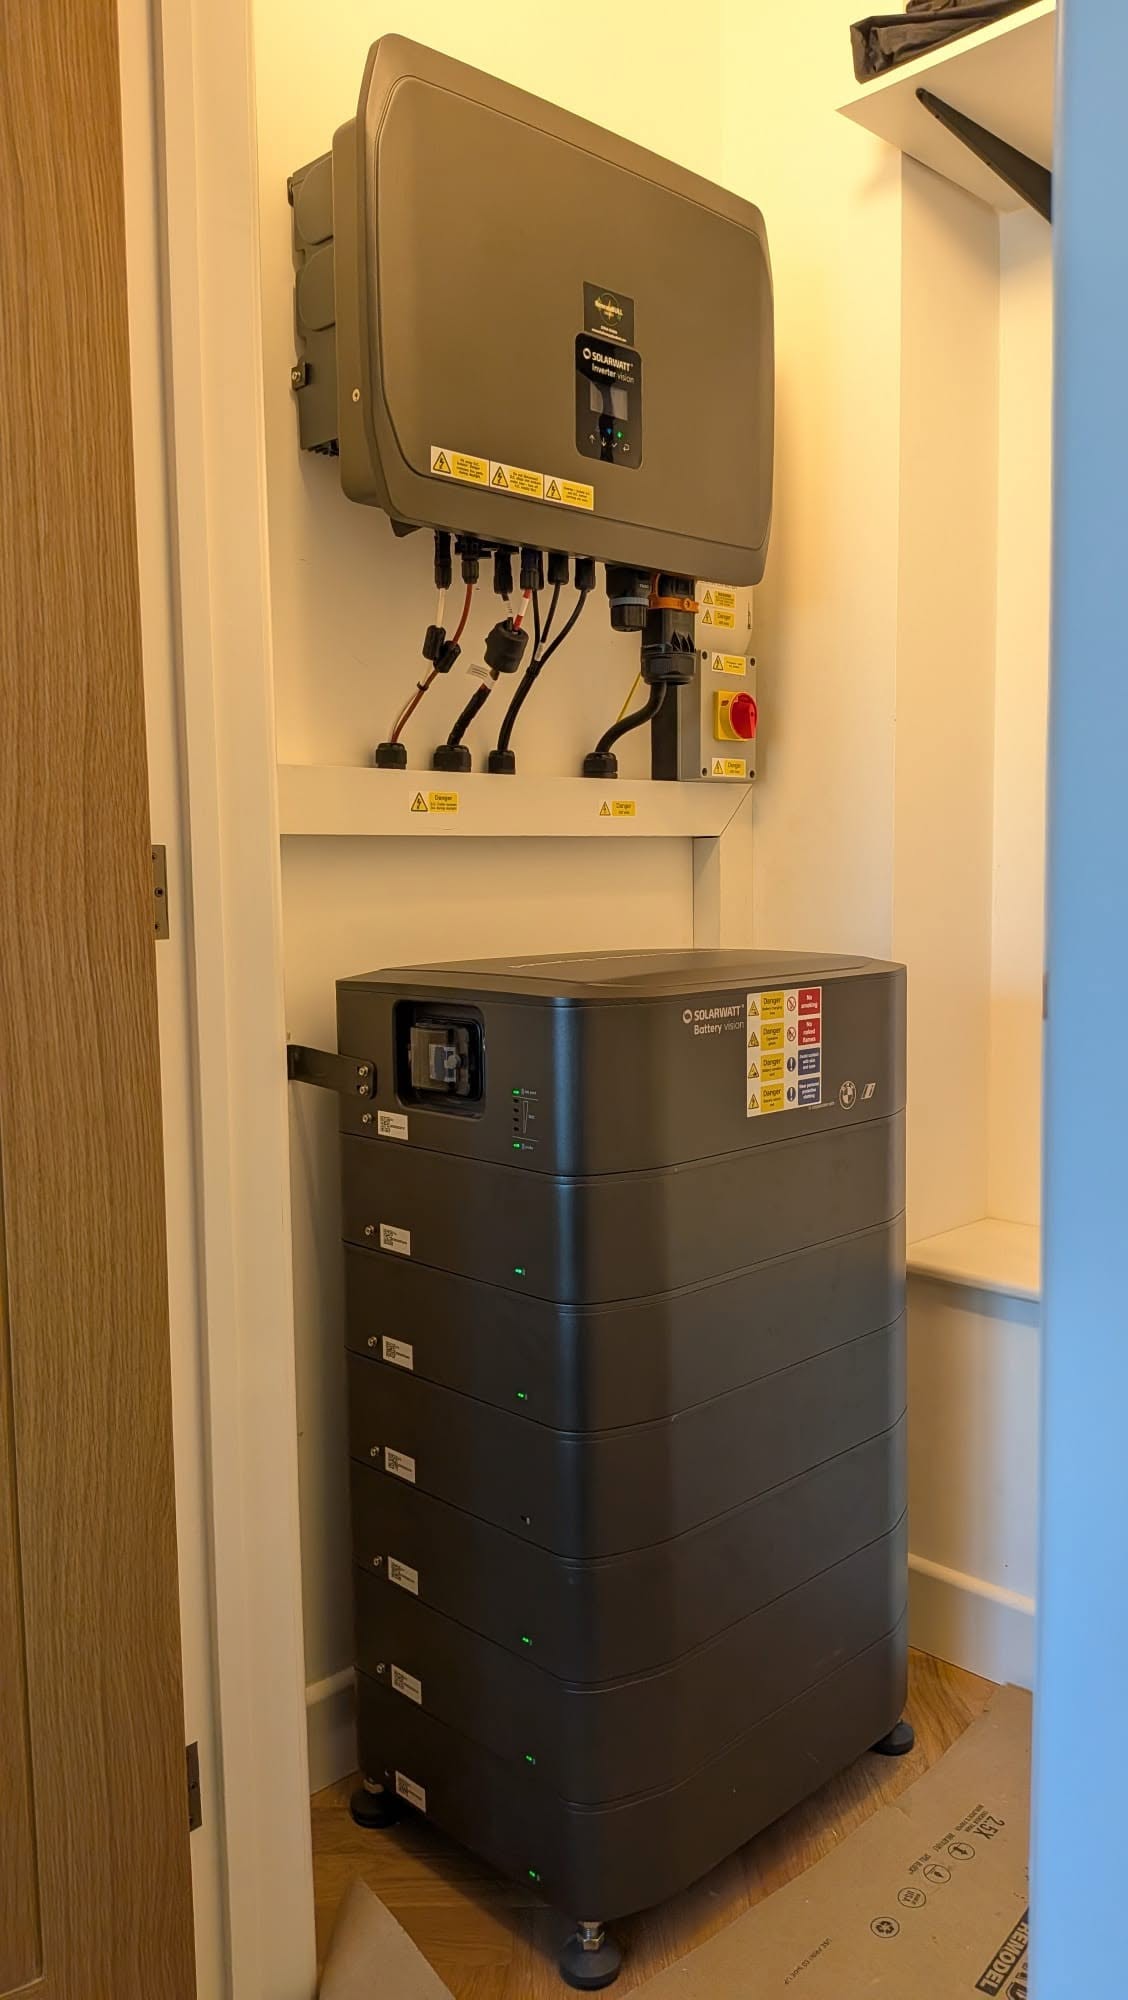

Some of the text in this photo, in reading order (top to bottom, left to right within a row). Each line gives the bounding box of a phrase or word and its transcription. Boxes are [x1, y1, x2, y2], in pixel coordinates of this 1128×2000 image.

[592, 352, 633, 372] SOLARWATT
[591, 363, 635, 384] Inverter vision
[434, 794, 453, 802] Danger
[763, 997, 782, 1005] Danger
[694, 1006, 741, 1021] SOLARWATT
[694, 1021, 745, 1036] Battery vision
[763, 1027, 782, 1036] Danger
[763, 1057, 782, 1067] Danger
[763, 1088, 782, 1098] Danger
[973, 1815, 1005, 1839] 2.5X
